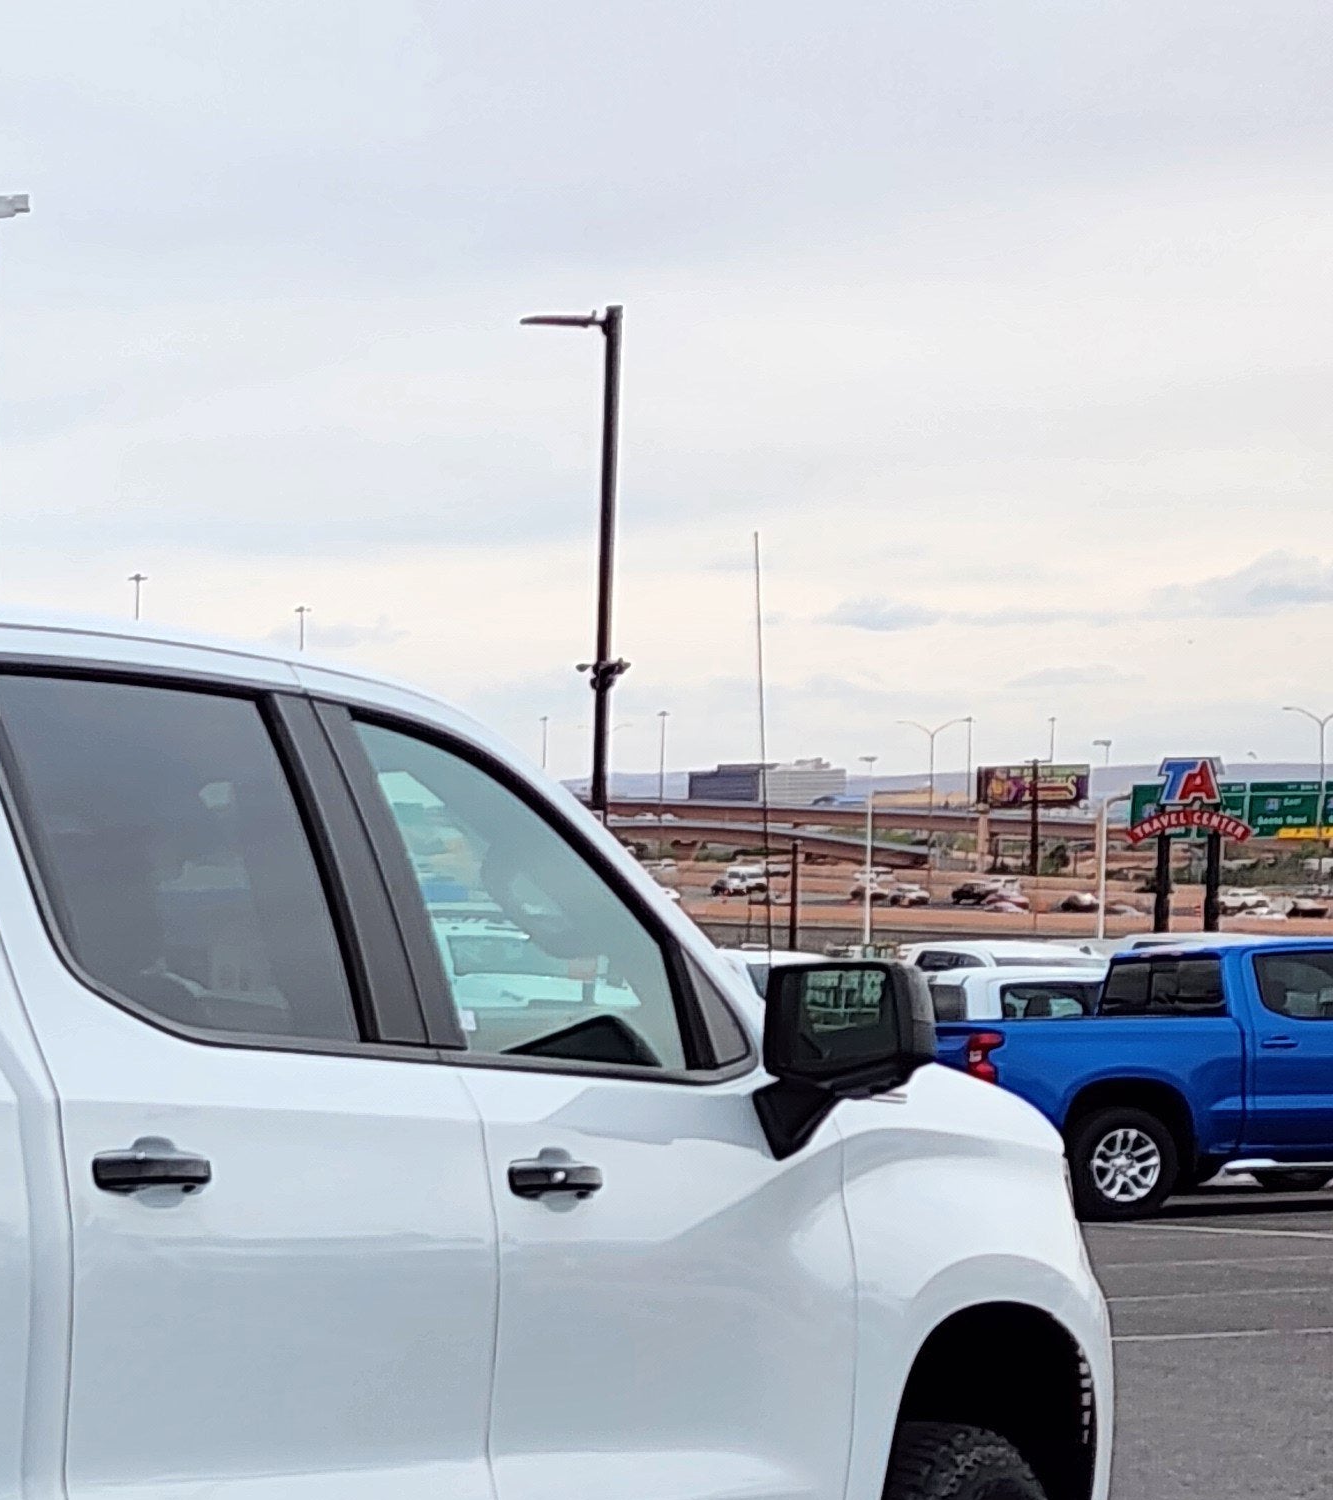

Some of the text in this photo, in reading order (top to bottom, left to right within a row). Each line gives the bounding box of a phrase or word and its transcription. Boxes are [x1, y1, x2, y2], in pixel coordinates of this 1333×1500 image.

[1158, 757, 1222, 804] TA
[1133, 811, 1247, 839] TRAVEL CENTER
